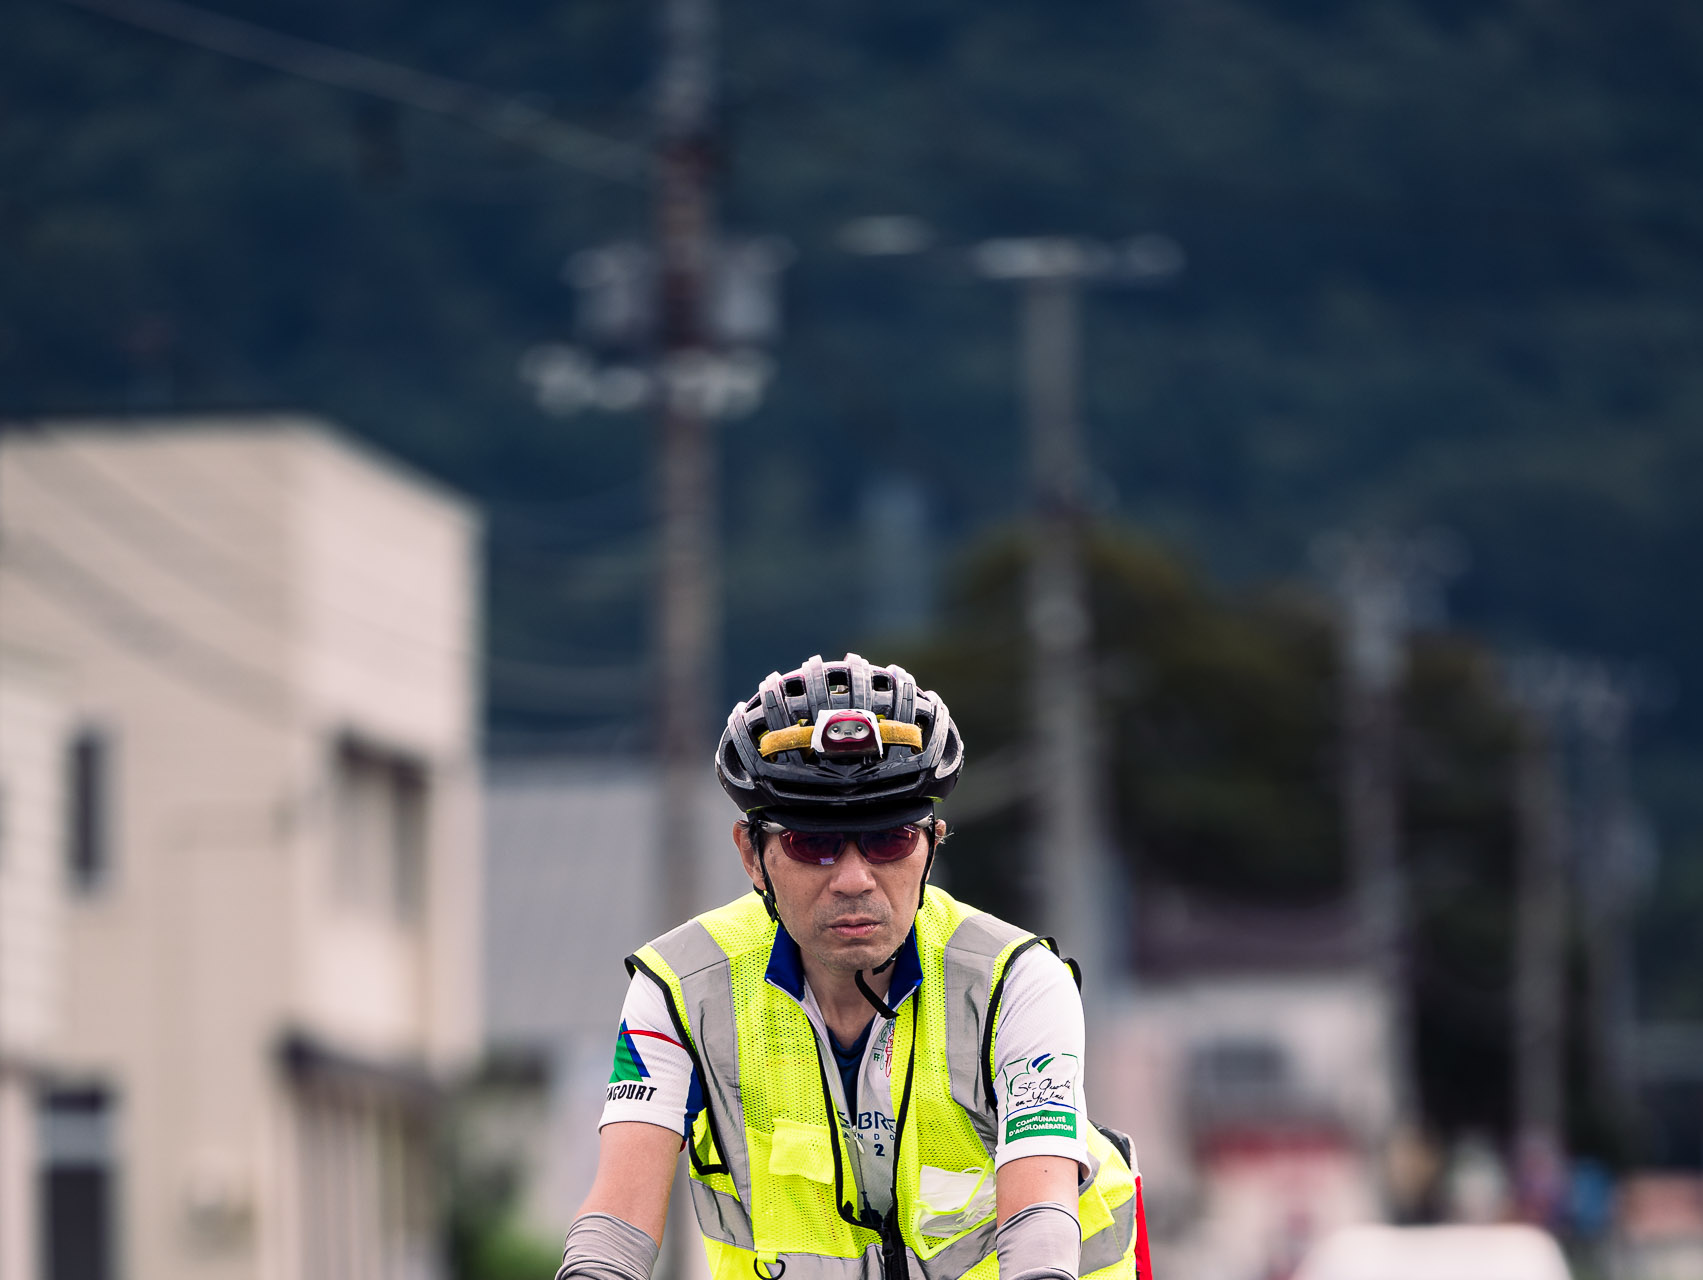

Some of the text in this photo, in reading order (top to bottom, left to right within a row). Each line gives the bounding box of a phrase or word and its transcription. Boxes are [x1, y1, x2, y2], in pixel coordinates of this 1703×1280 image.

[1015, 1115, 1067, 1128] COMMUNAUTÉ
[1008, 1122, 1074, 1138] D'AGGLOMÉRATION
[873, 1143, 886, 1158] 2
